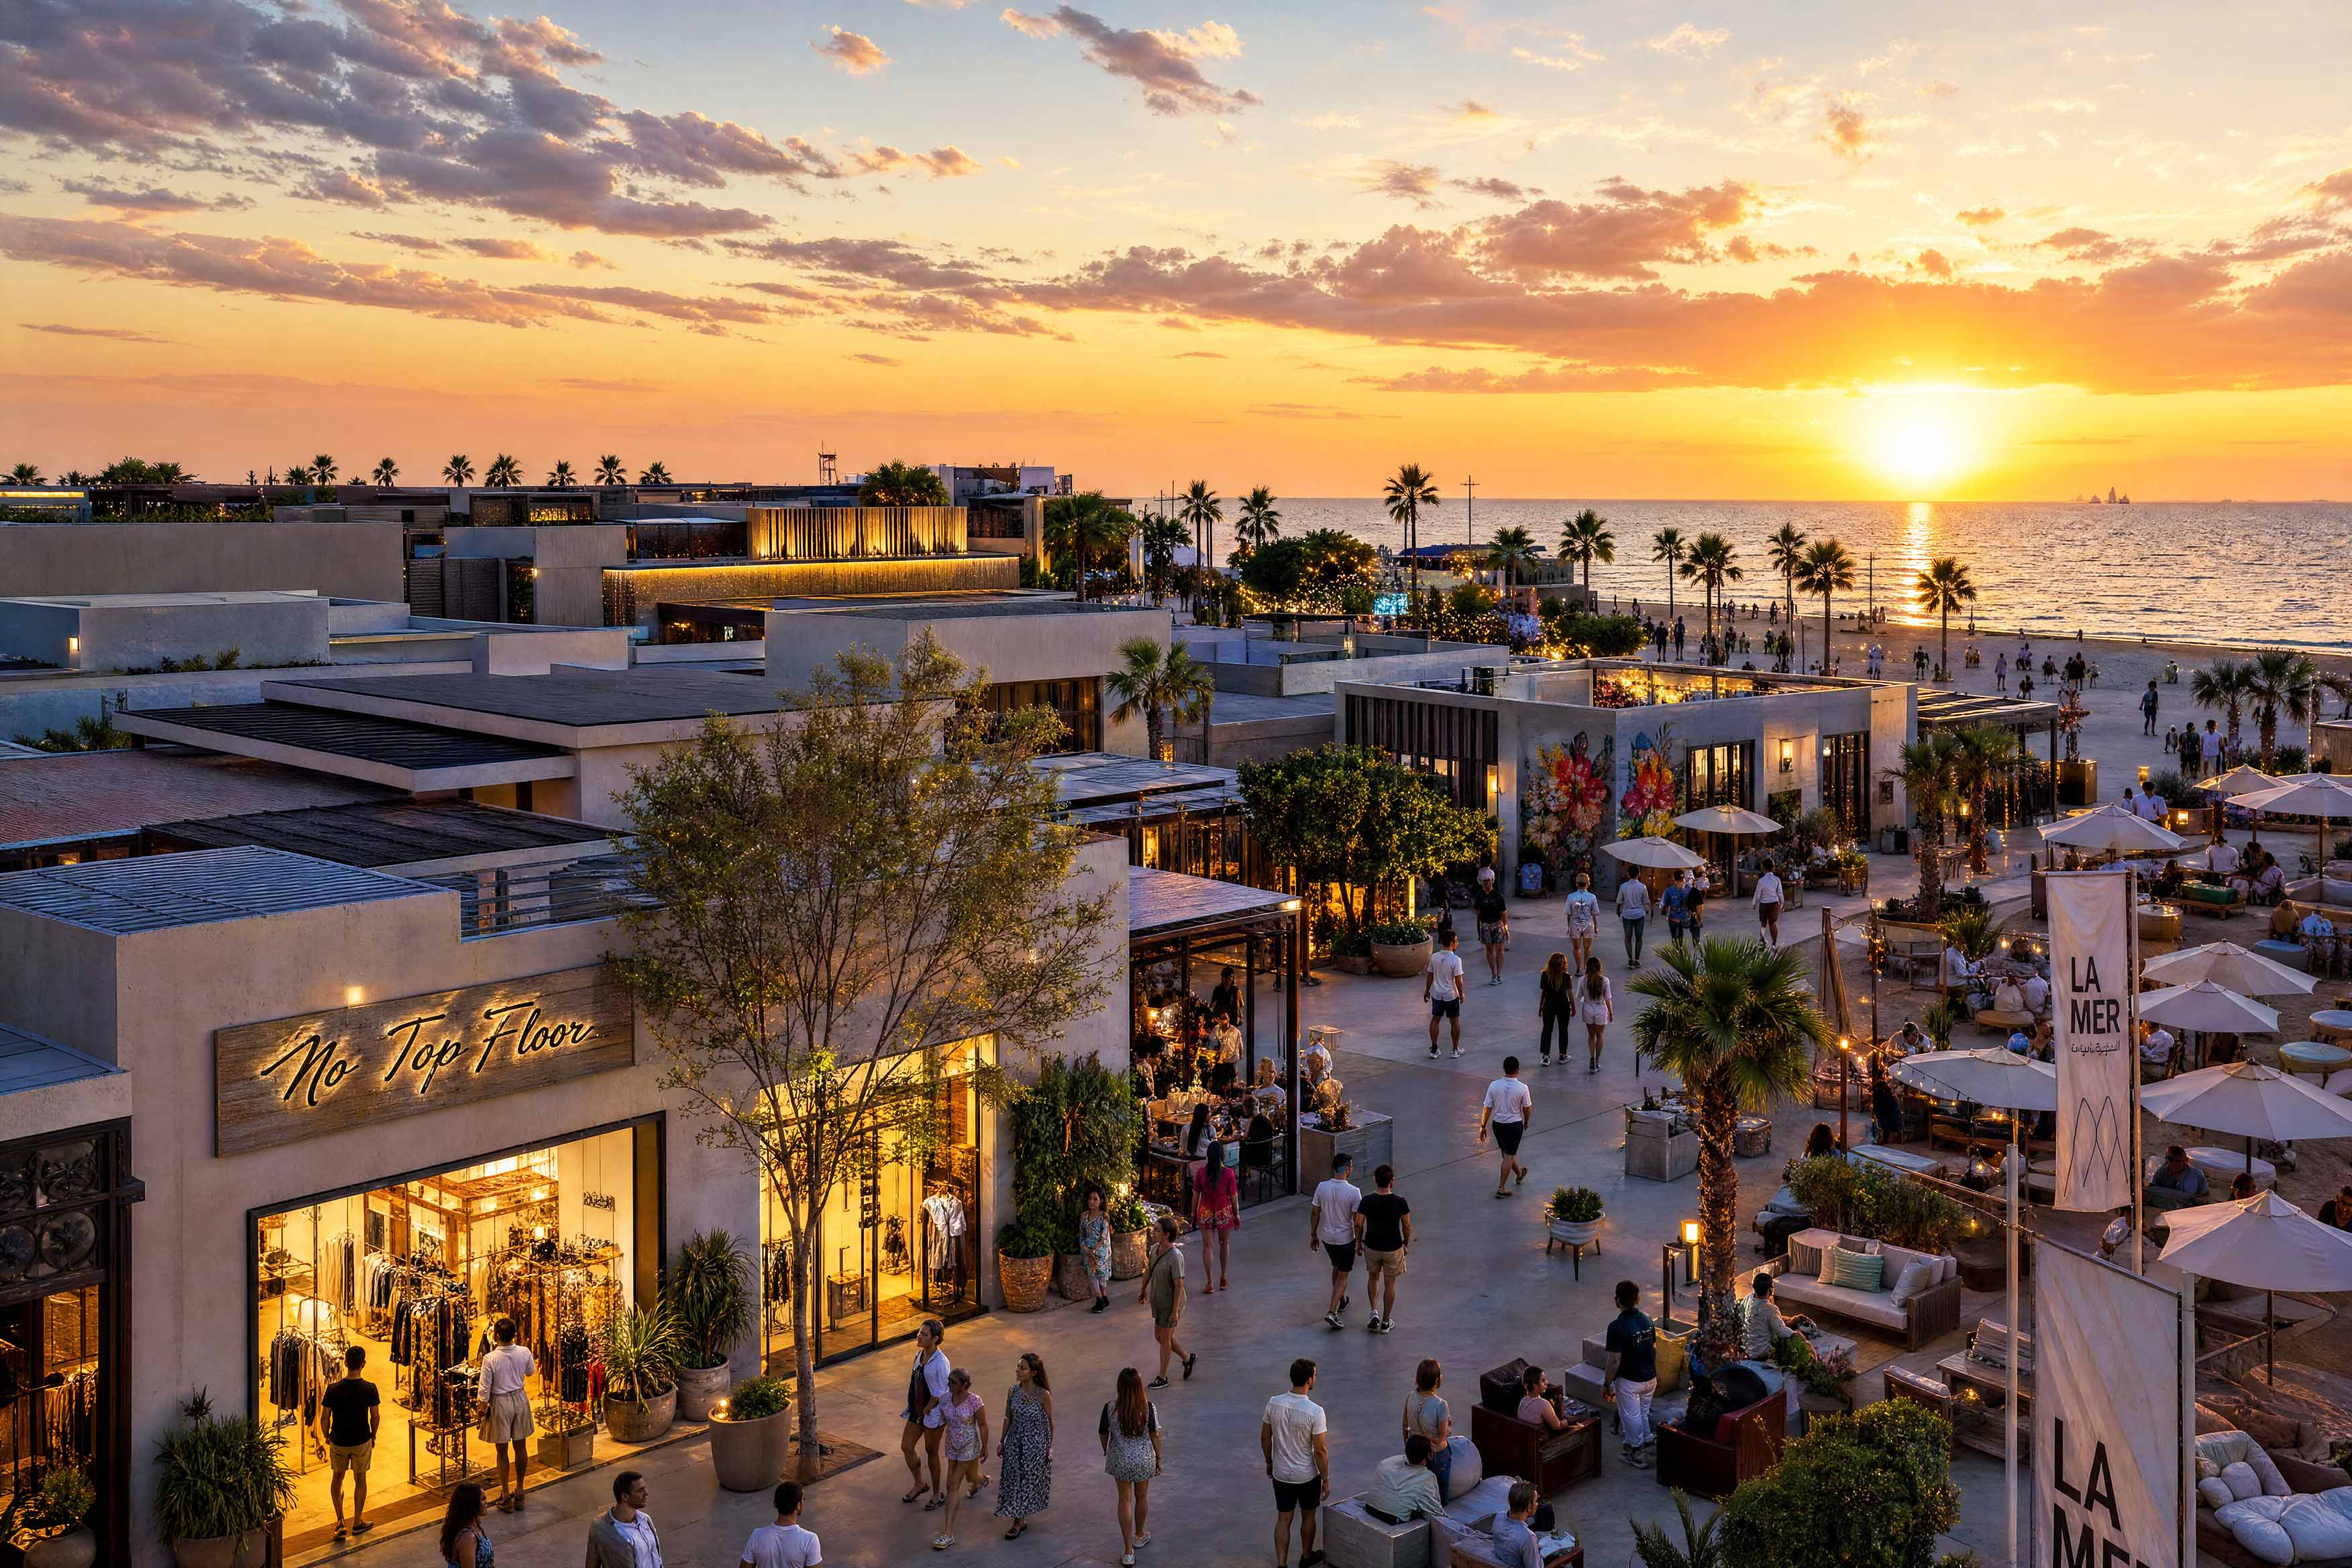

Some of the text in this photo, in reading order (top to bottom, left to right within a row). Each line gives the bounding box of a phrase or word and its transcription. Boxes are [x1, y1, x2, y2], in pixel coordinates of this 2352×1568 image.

[2071, 956, 2102, 993] LA
[2070, 998, 2121, 1035] MER
[260, 1001, 595, 1106] No Top Floor
[2054, 1416, 2122, 1532] LA
